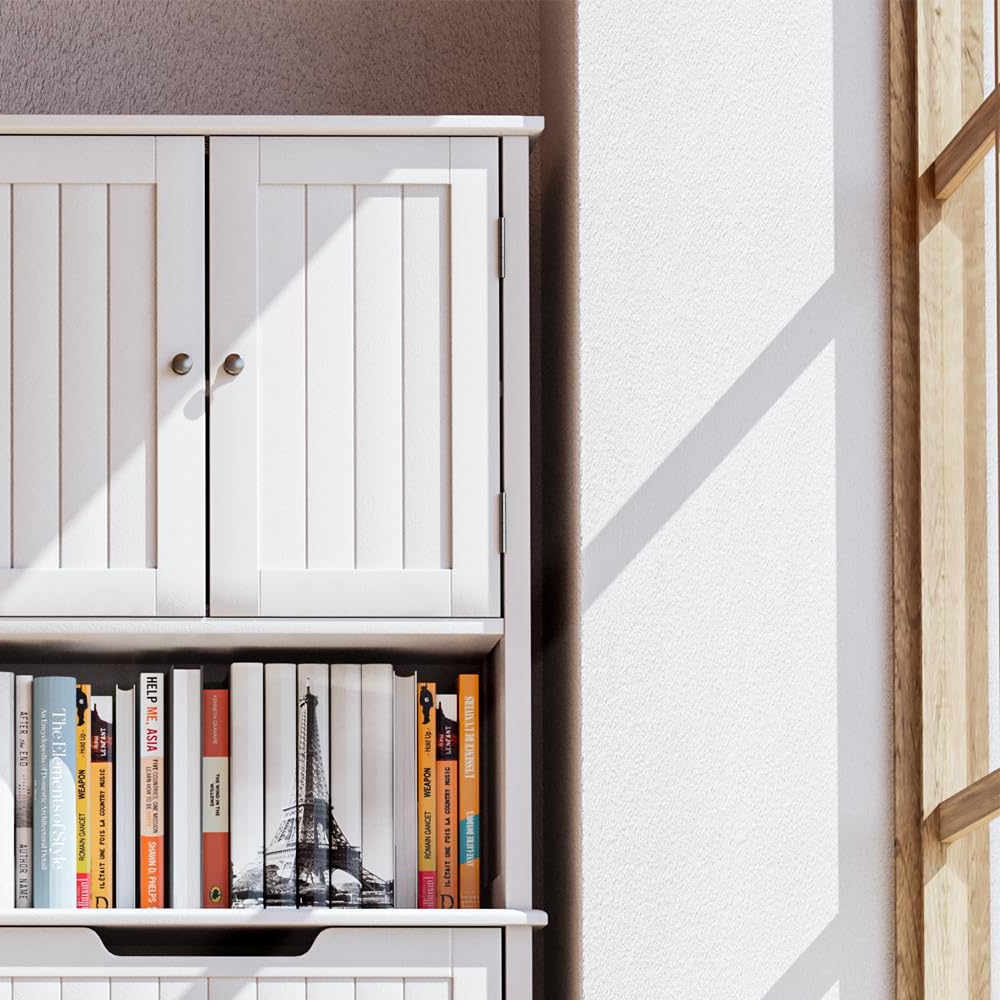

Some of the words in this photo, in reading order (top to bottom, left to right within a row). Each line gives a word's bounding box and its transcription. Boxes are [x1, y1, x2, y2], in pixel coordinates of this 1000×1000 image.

[146, 676, 158, 703] HELP
[19, 711, 29, 735] AFTER
[52, 707, 67, 739] The
[145, 706, 158, 725] ME,
[146, 728, 158, 752] ASIA
[424, 740, 432, 753] Hold
[19, 751, 29, 767] END
[52, 742, 67, 811] Elements
[78, 770, 86, 800] WEAPON
[423, 768, 432, 798] WEAPON
[78, 813, 86, 836] GANCET
[423, 811, 432, 836] GANCET
[19, 844, 28, 873] AUTHOR
[49, 830, 67, 870] Style
[78, 837, 86, 862] ROMAIN
[148, 841, 157, 866] SHAWN
[423, 836, 432, 860] ROMAIN
[19, 878, 28, 900] NAME
[148, 876, 157, 904] PHELPS
